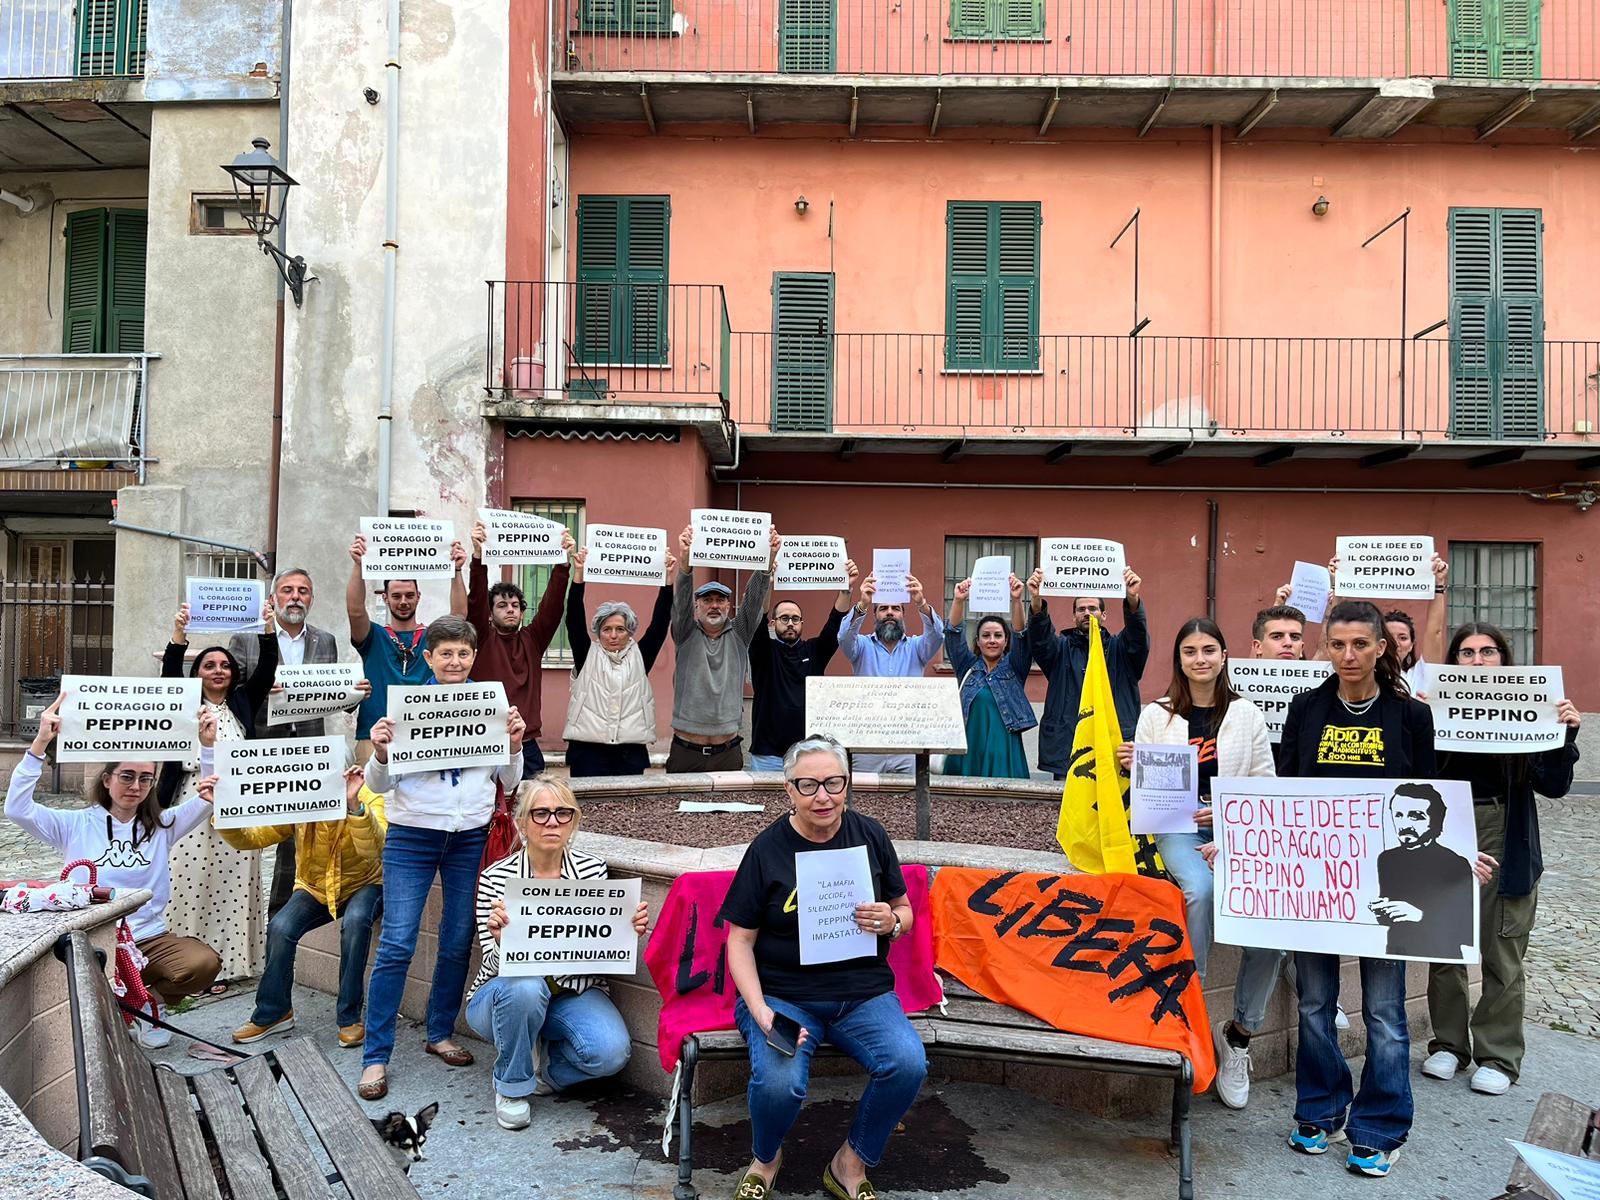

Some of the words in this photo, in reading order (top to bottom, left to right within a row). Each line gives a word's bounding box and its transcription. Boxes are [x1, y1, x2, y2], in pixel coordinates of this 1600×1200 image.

[711, 527, 751, 535] CORAGGIO
[498, 534, 549, 542] PEPPINO
[706, 538, 756, 548] PEPPINO
[380, 548, 437, 556] PEPPINO
[605, 543, 646, 551] CORAGGIO
[601, 553, 651, 564] PEPPINO
[710, 553, 766, 562] CONTINUIAMO!
[605, 569, 662, 577] CONTINUIAMO!
[1056, 567, 1109, 576] PEPPINO
[1354, 567, 1415, 576] PEPPINO
[1060, 582, 1121, 590] CONTINUIAMO!
[1234, 667, 1258, 675] CON
[1282, 669, 1309, 677] IDEE
[1439, 674, 1466, 682] CON
[1472, 675, 1488, 683] LE
[1493, 676, 1524, 684] IDEE
[1530, 676, 1546, 684] ED
[79, 685, 107, 693] CON
[113, 686, 128, 694] LE
[288, 692, 346, 702] PEPPINO
[405, 695, 430, 703] CON
[435, 694, 448, 702] LE
[453, 692, 478, 701] IDEE
[483, 691, 496, 699] ED
[1456, 692, 1528, 702] CORAGGIO
[1534, 694, 1547, 702] DI
[78, 702, 90, 710] IL
[95, 703, 165, 711] CORAGGIO
[170, 703, 182, 711] DI
[829, 701, 874, 710] Peppino
[882, 702, 938, 710] Impastato
[404, 713, 414, 721] IL
[419, 709, 481, 720] CORAGGIO
[1448, 708, 1538, 722] PEPPINO
[86, 719, 172, 730] PEPPINO
[410, 724, 486, 740] PEPPINO
[1456, 731, 1558, 741] CONTINUIAMO!
[64, 741, 87, 749] NOI
[93, 741, 191, 749] CONTINUIAMO!
[231, 749, 257, 758] CON
[263, 748, 277, 756] LE
[282, 747, 310, 755] IDEE
[393, 752, 412, 761] NOI
[417, 745, 504, 758] CONTINUIAMO!
[247, 763, 313, 774] CORAGGIO
[240, 779, 321, 795] PEPPINO
[220, 807, 242, 816] NOI
[248, 800, 340, 813] CONTINUIAMO!
[1225, 800, 1274, 826] CON
[1282, 800, 1306, 827] LE
[1311, 800, 1361, 828] IDEE
[1245, 829, 1341, 859] CORAGGIO
[1349, 833, 1366, 858] DI
[1230, 858, 1304, 888] PEPPINO
[1325, 860, 1359, 890] NOI
[522, 888, 550, 896] CON
[575, 889, 604, 897] IDEE
[609, 890, 625, 898] ED
[819, 892, 846, 900] UCCIDE,
[808, 904, 839, 912] SILENZIO
[1229, 887, 1355, 920] CONTINUIAMO
[521, 907, 532, 915] IL
[537, 907, 605, 915] CORAGGIO
[528, 925, 612, 938] PEPPINO
[813, 928, 862, 940] IMPASTATO
[506, 952, 529, 961] NOI
[534, 951, 630, 960] CONTINUIAMO!
